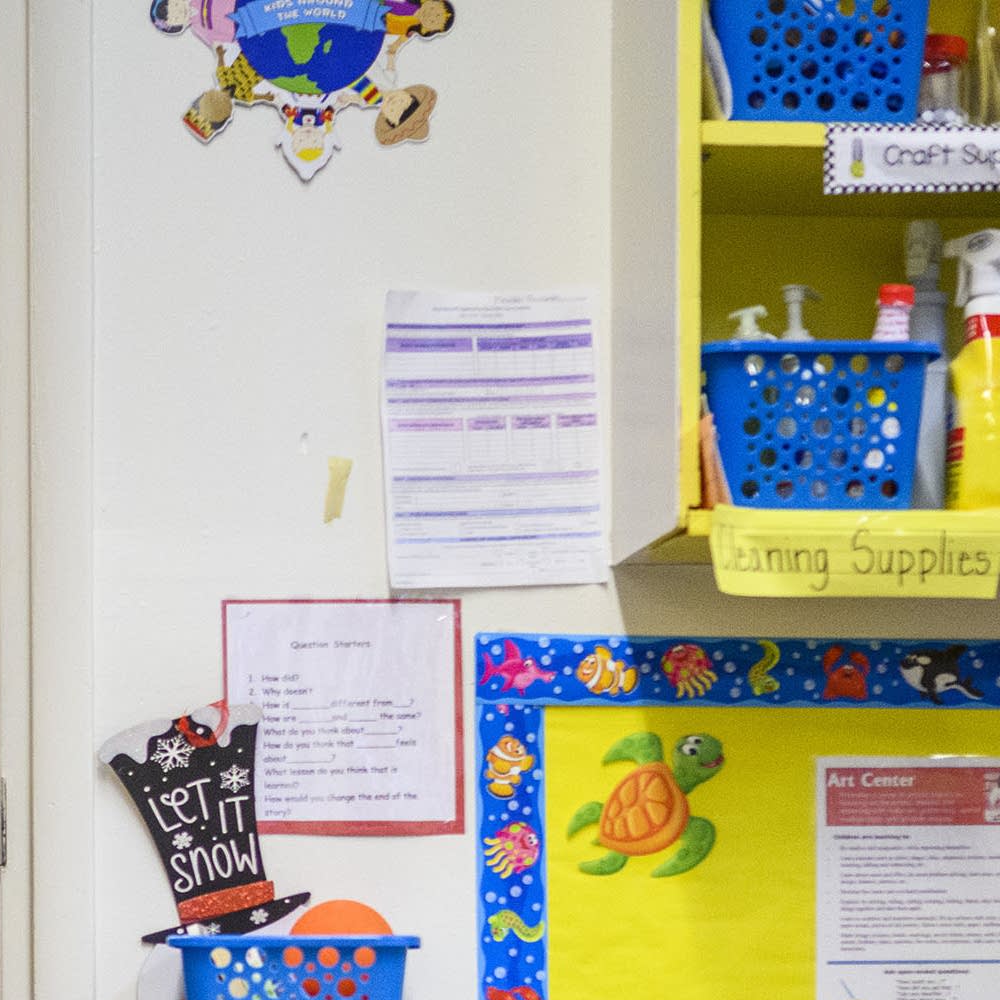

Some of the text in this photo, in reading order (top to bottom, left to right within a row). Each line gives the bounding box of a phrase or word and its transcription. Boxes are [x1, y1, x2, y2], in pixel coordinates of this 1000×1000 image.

[277, 7, 348, 21] THE WORLD
[883, 143, 955, 167] Craft
[851, 528, 993, 587] Supplies
[290, 640, 371, 650] Question Starters
[262, 673, 279, 682] How
[262, 687, 281, 698] Why
[262, 700, 280, 710] How
[330, 699, 370, 708] different
[372, 698, 393, 708] from
[262, 713, 280, 723] How
[379, 711, 394, 720] the
[396, 711, 422, 720] same?
[263, 727, 286, 737] What
[288, 727, 299, 737] do
[301, 729, 316, 738] you
[318, 726, 339, 735] think
[341, 725, 364, 735] about
[263, 740, 281, 749] How
[283, 740, 293, 750] do
[295, 742, 311, 752] you
[312, 740, 334, 749] think
[336, 739, 355, 748] that
[262, 754, 287, 764] about
[264, 767, 287, 777] What
[317, 767, 328, 776] do
[330, 767, 345, 778] you
[347, 766, 368, 775] think
[370, 765, 389, 775] that
[828, 772, 914, 787] Art Center
[264, 791, 418, 805] How would you change the end of the
[218, 795, 250, 834] IT
